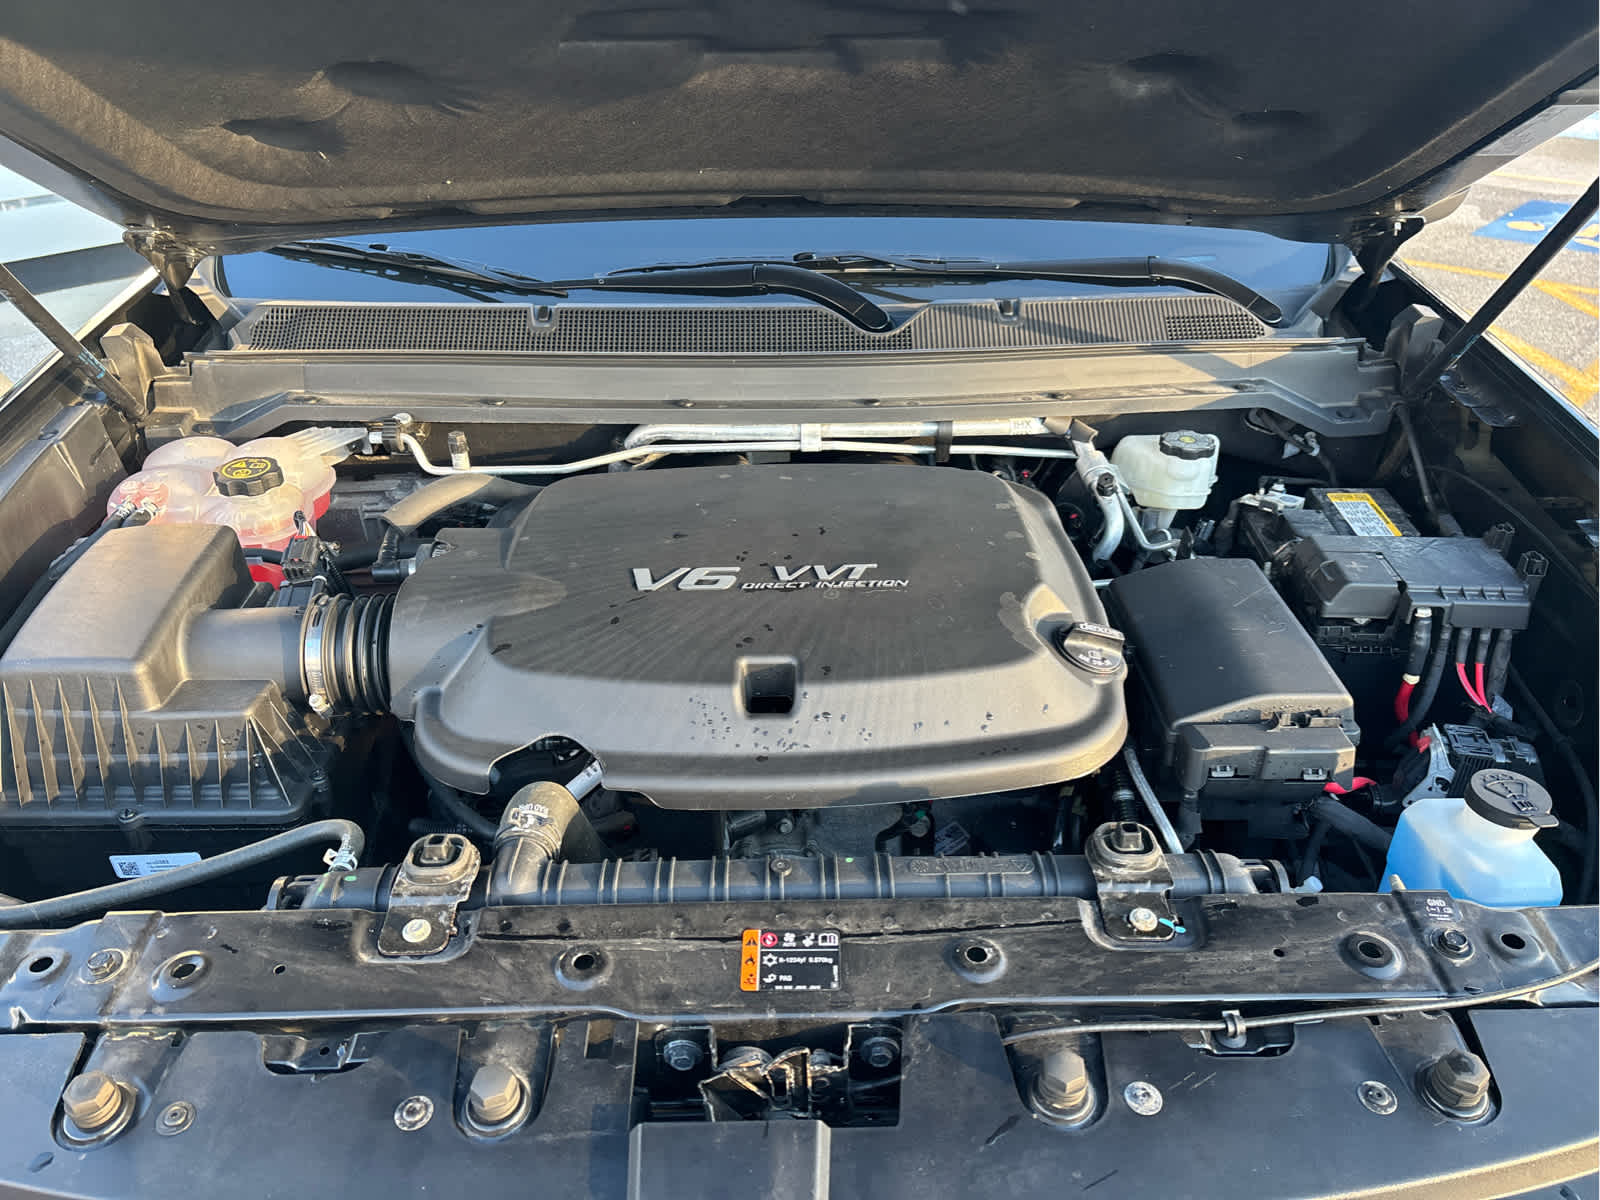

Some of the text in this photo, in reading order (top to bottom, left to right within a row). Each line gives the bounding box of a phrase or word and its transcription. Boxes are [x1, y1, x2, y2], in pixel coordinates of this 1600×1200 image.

[632, 563, 878, 591] V6 VVT
[741, 579, 910, 590] DIRECT INJECTION
